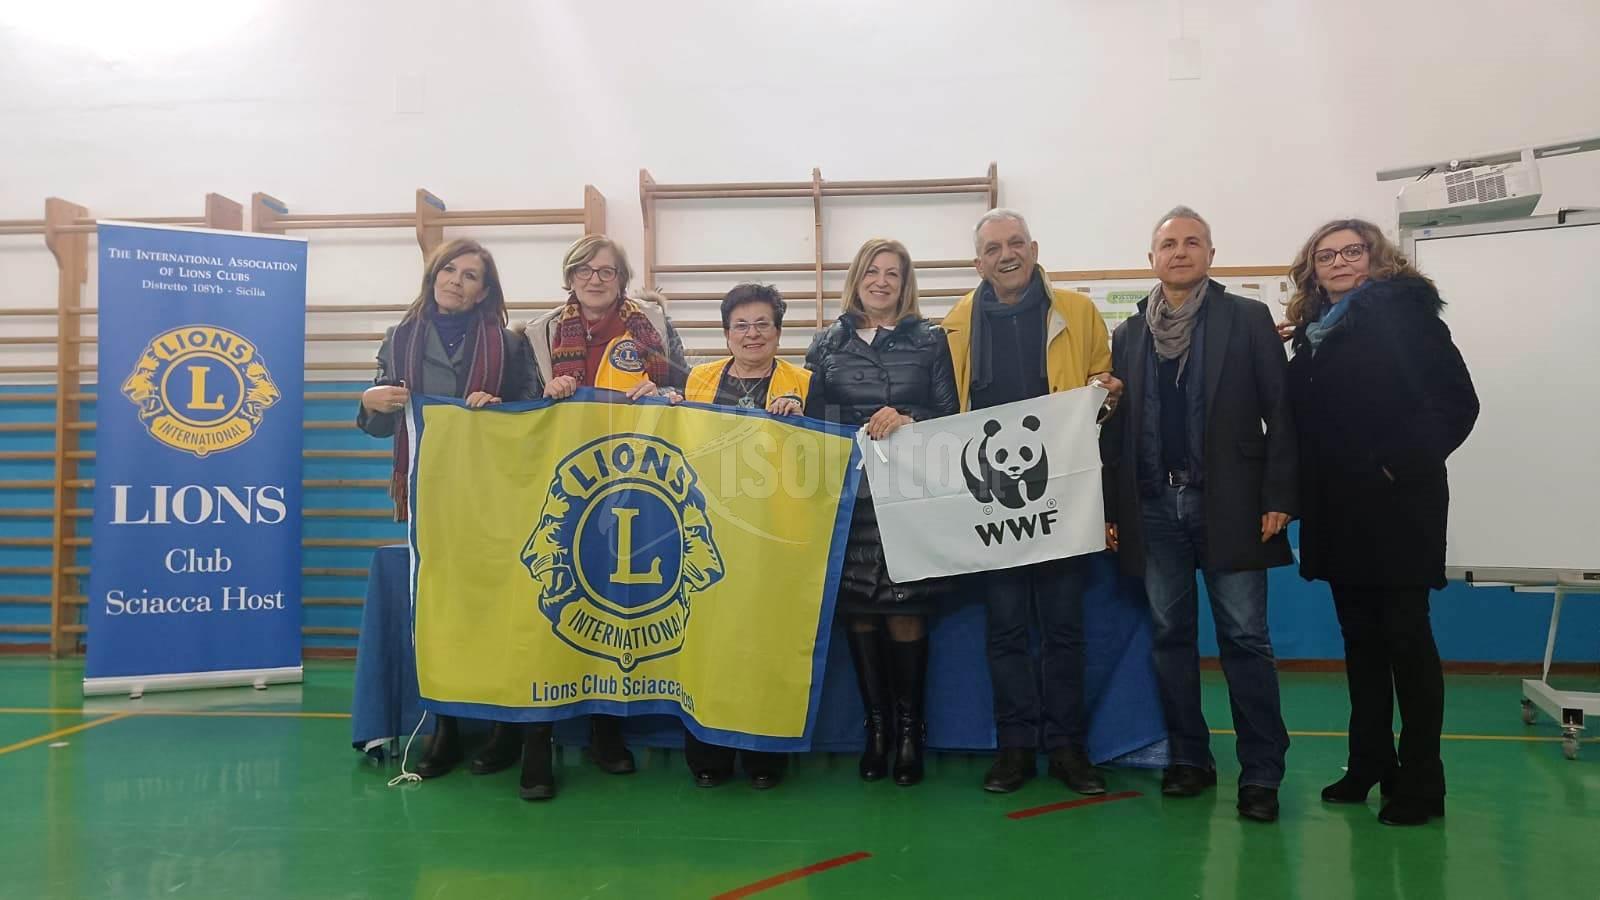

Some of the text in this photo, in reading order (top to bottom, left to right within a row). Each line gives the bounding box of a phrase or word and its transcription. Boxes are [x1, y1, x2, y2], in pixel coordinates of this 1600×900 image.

[108, 247, 298, 272] THE INTERNATIONAL ASSOCIATION
[159, 266, 250, 282] OF LIONS CLUBS
[142, 279, 188, 292] Distretto
[193, 283, 223, 294] 108Yb
[236, 286, 266, 297] Sicilia
[159, 330, 248, 360] LIONS
[186, 366, 225, 410] L
[158, 420, 246, 446] INTERNATIONAL
[568, 442, 687, 494] LIONS
[109, 484, 287, 525] LIONS
[974, 509, 1058, 547] WWF
[165, 547, 232, 574] Club
[609, 507, 663, 584] L
[105, 586, 285, 616] Sciacca Host
[568, 608, 682, 651] INTERNATIONA
[532, 681, 577, 702] Lions
[581, 674, 617, 695] Club
[622, 676, 682, 697] Sciacca
